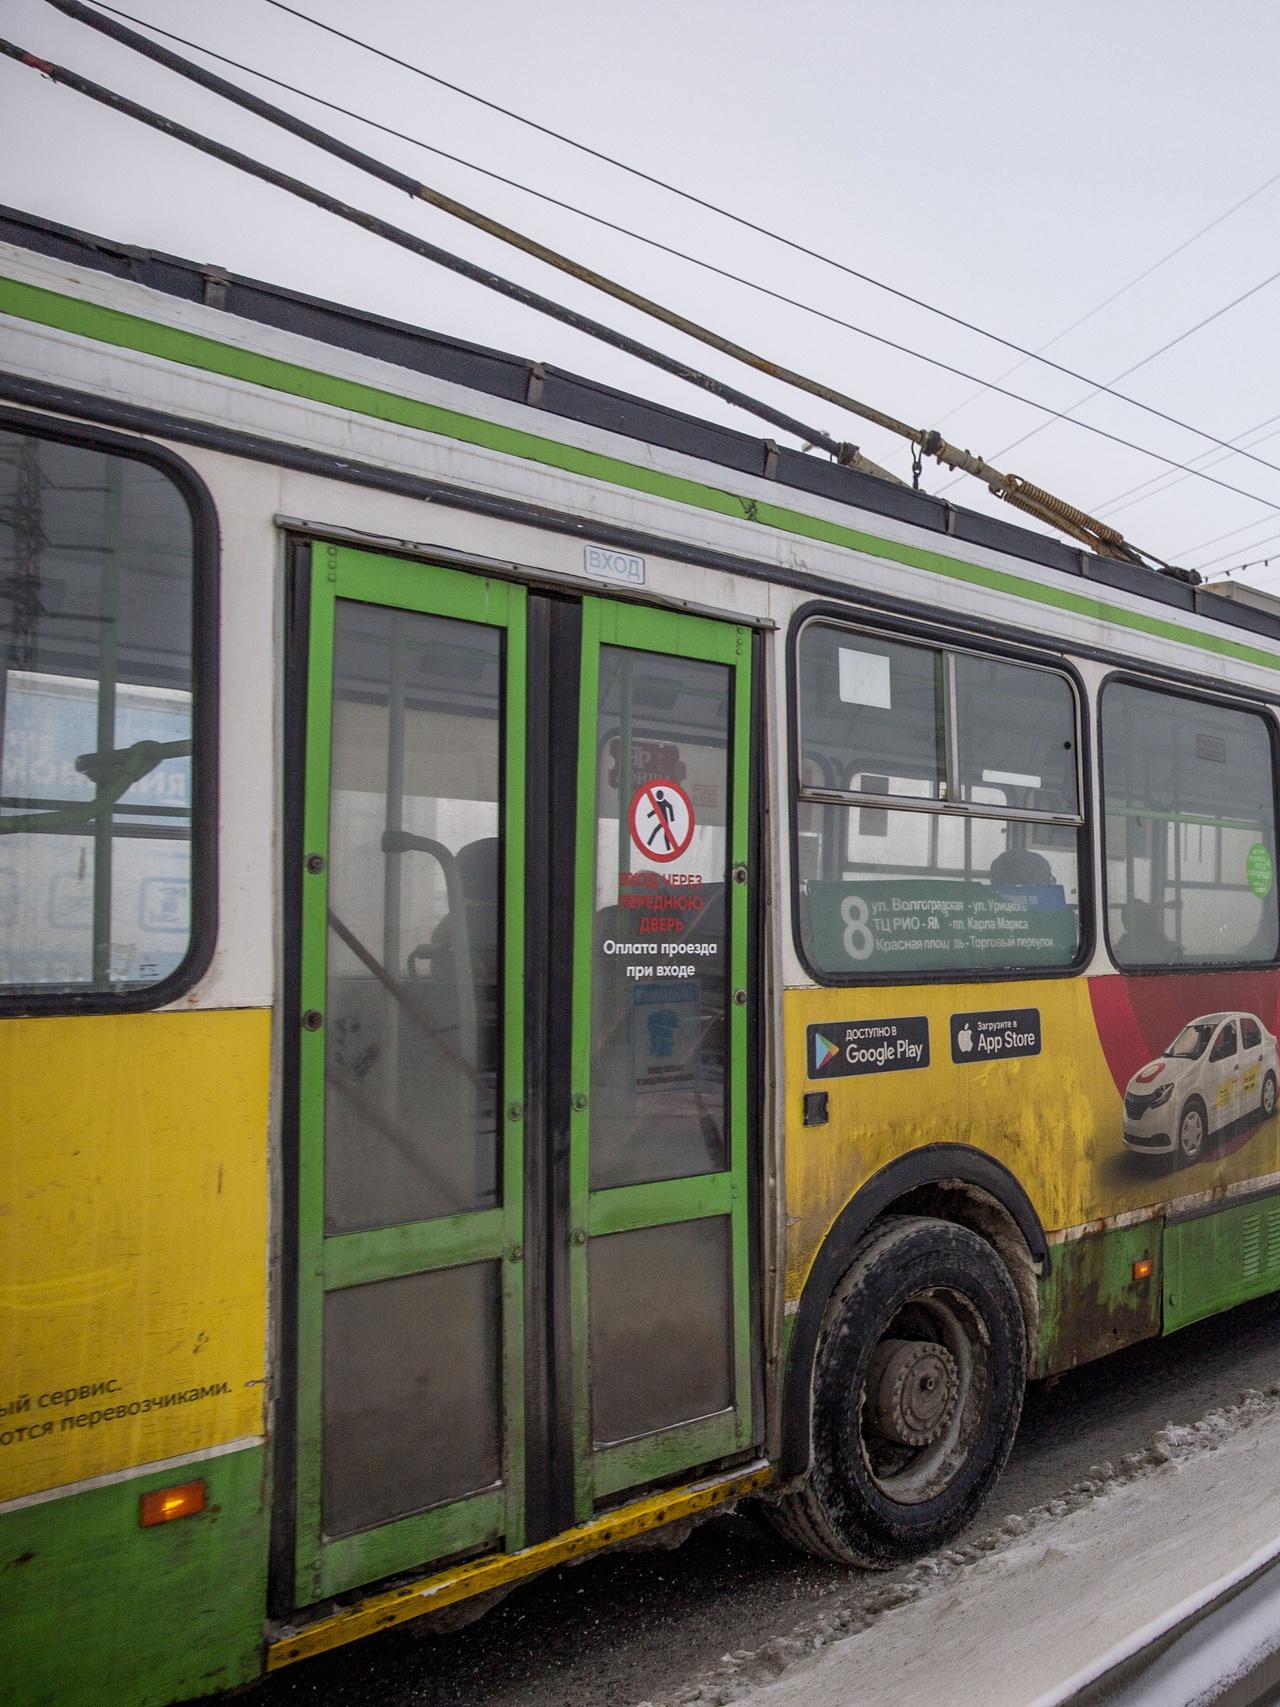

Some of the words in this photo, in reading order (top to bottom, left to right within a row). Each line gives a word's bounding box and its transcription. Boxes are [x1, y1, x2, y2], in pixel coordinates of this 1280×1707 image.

[590, 550, 641, 581] ВХОД
[663, 873, 704, 889] ЧЕРЕЗ
[871, 901, 889, 915] ул.
[972, 901, 986, 914] ул.
[640, 917, 685, 934] ДВЕРЬ
[841, 895, 874, 960] 8
[872, 917, 891, 933] ТЦ
[893, 916, 920, 930] РИО
[968, 917, 996, 932] Карла
[997, 917, 1029, 932] Маркса
[603, 940, 657, 955] Оплата
[661, 943, 717, 957] проезда
[876, 938, 921, 953] Красная
[626, 966, 653, 980] при
[656, 965, 696, 978] входе
[845, 1028, 890, 1042] ДОСТУПНО
[891, 1026, 897, 1036] В
[977, 1020, 1012, 1031] Загрузите
[977, 1033, 1002, 1053] App
[1004, 1030, 1036, 1048] Store
[846, 1042, 895, 1066] Google
[896, 1040, 923, 1062] Play
[37, 1378, 123, 1408] сервис.
[59, 1381, 233, 1431] перевозчиками.
